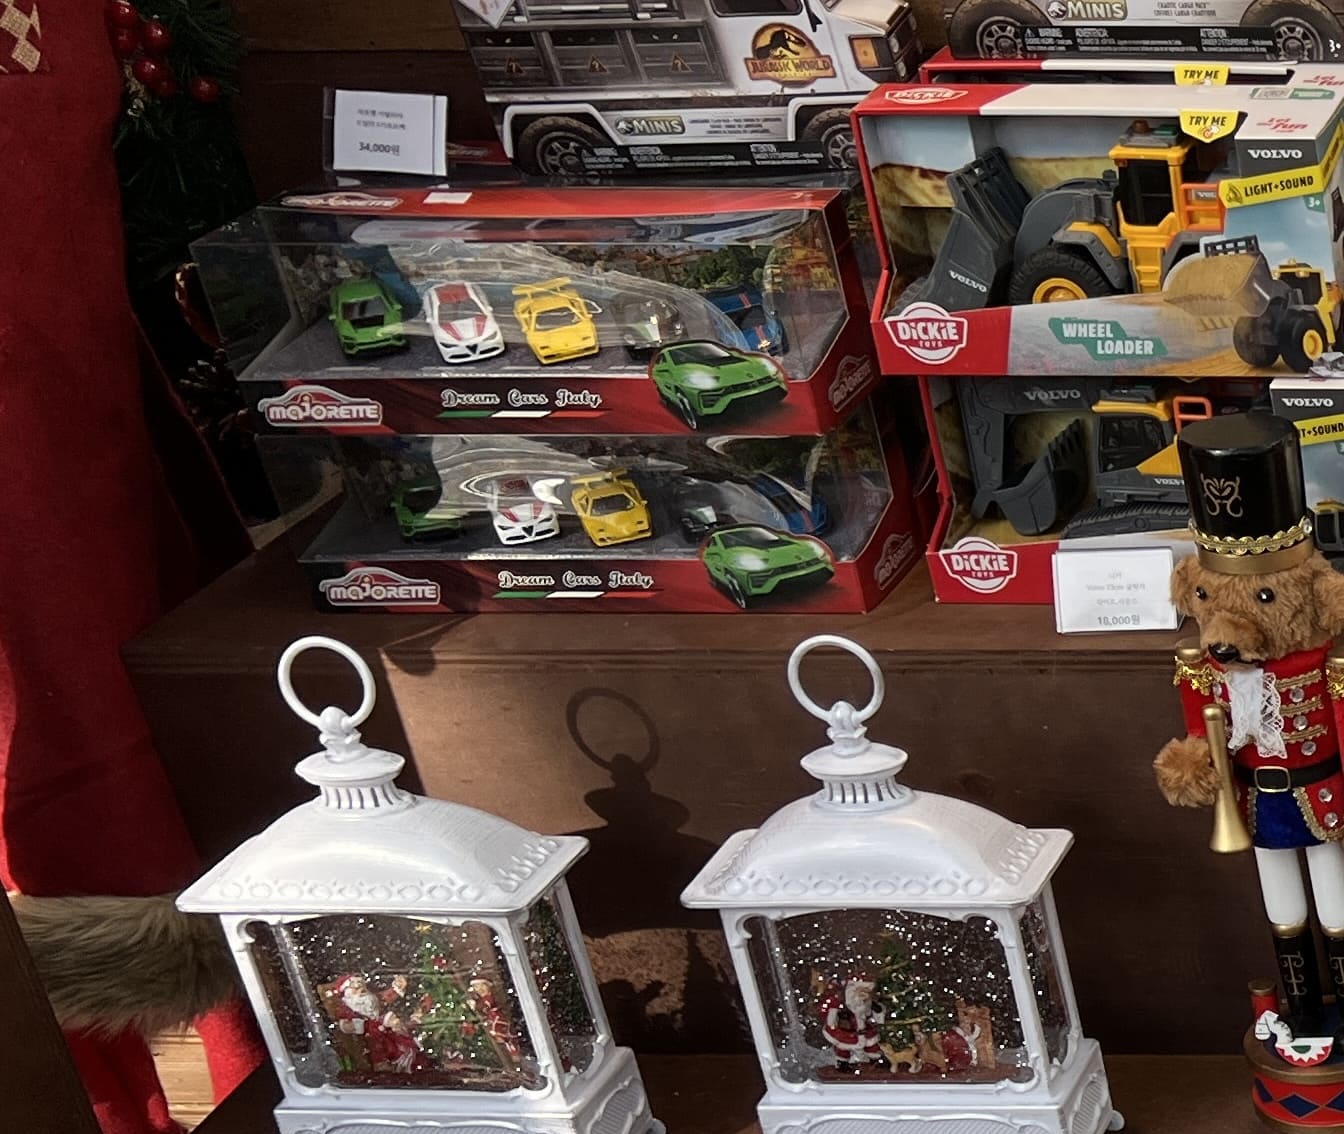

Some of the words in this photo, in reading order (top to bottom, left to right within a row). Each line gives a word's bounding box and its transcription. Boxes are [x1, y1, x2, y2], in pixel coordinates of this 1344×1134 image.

[794, 60, 831, 72] WORLD
[1183, 70, 1204, 79] TRY
[1206, 69, 1219, 79] ME
[632, 118, 683, 134] MINIS
[1188, 116, 1209, 126] TRY
[1210, 116, 1227, 126] ME
[1247, 149, 1303, 159] VOLVO
[1244, 175, 1314, 197] LIGHT+SOUND
[949, 270, 988, 293] VOLVO
[1062, 323, 1114, 338] WHEEL
[918, 340, 944, 348] TOYS
[1096, 339, 1154, 355] LOADER
[441, 388, 500, 408] Dream
[507, 388, 549, 406] Cars
[555, 388, 602, 409] Italy
[1023, 389, 1082, 401] VOLVO
[1281, 398, 1334, 408] VOLVO
[1300, 422, 1344, 438] T+SOUND
[498, 570, 555, 588] Dream
[561, 570, 601, 587] Cars
[608, 570, 653, 589] Italy
